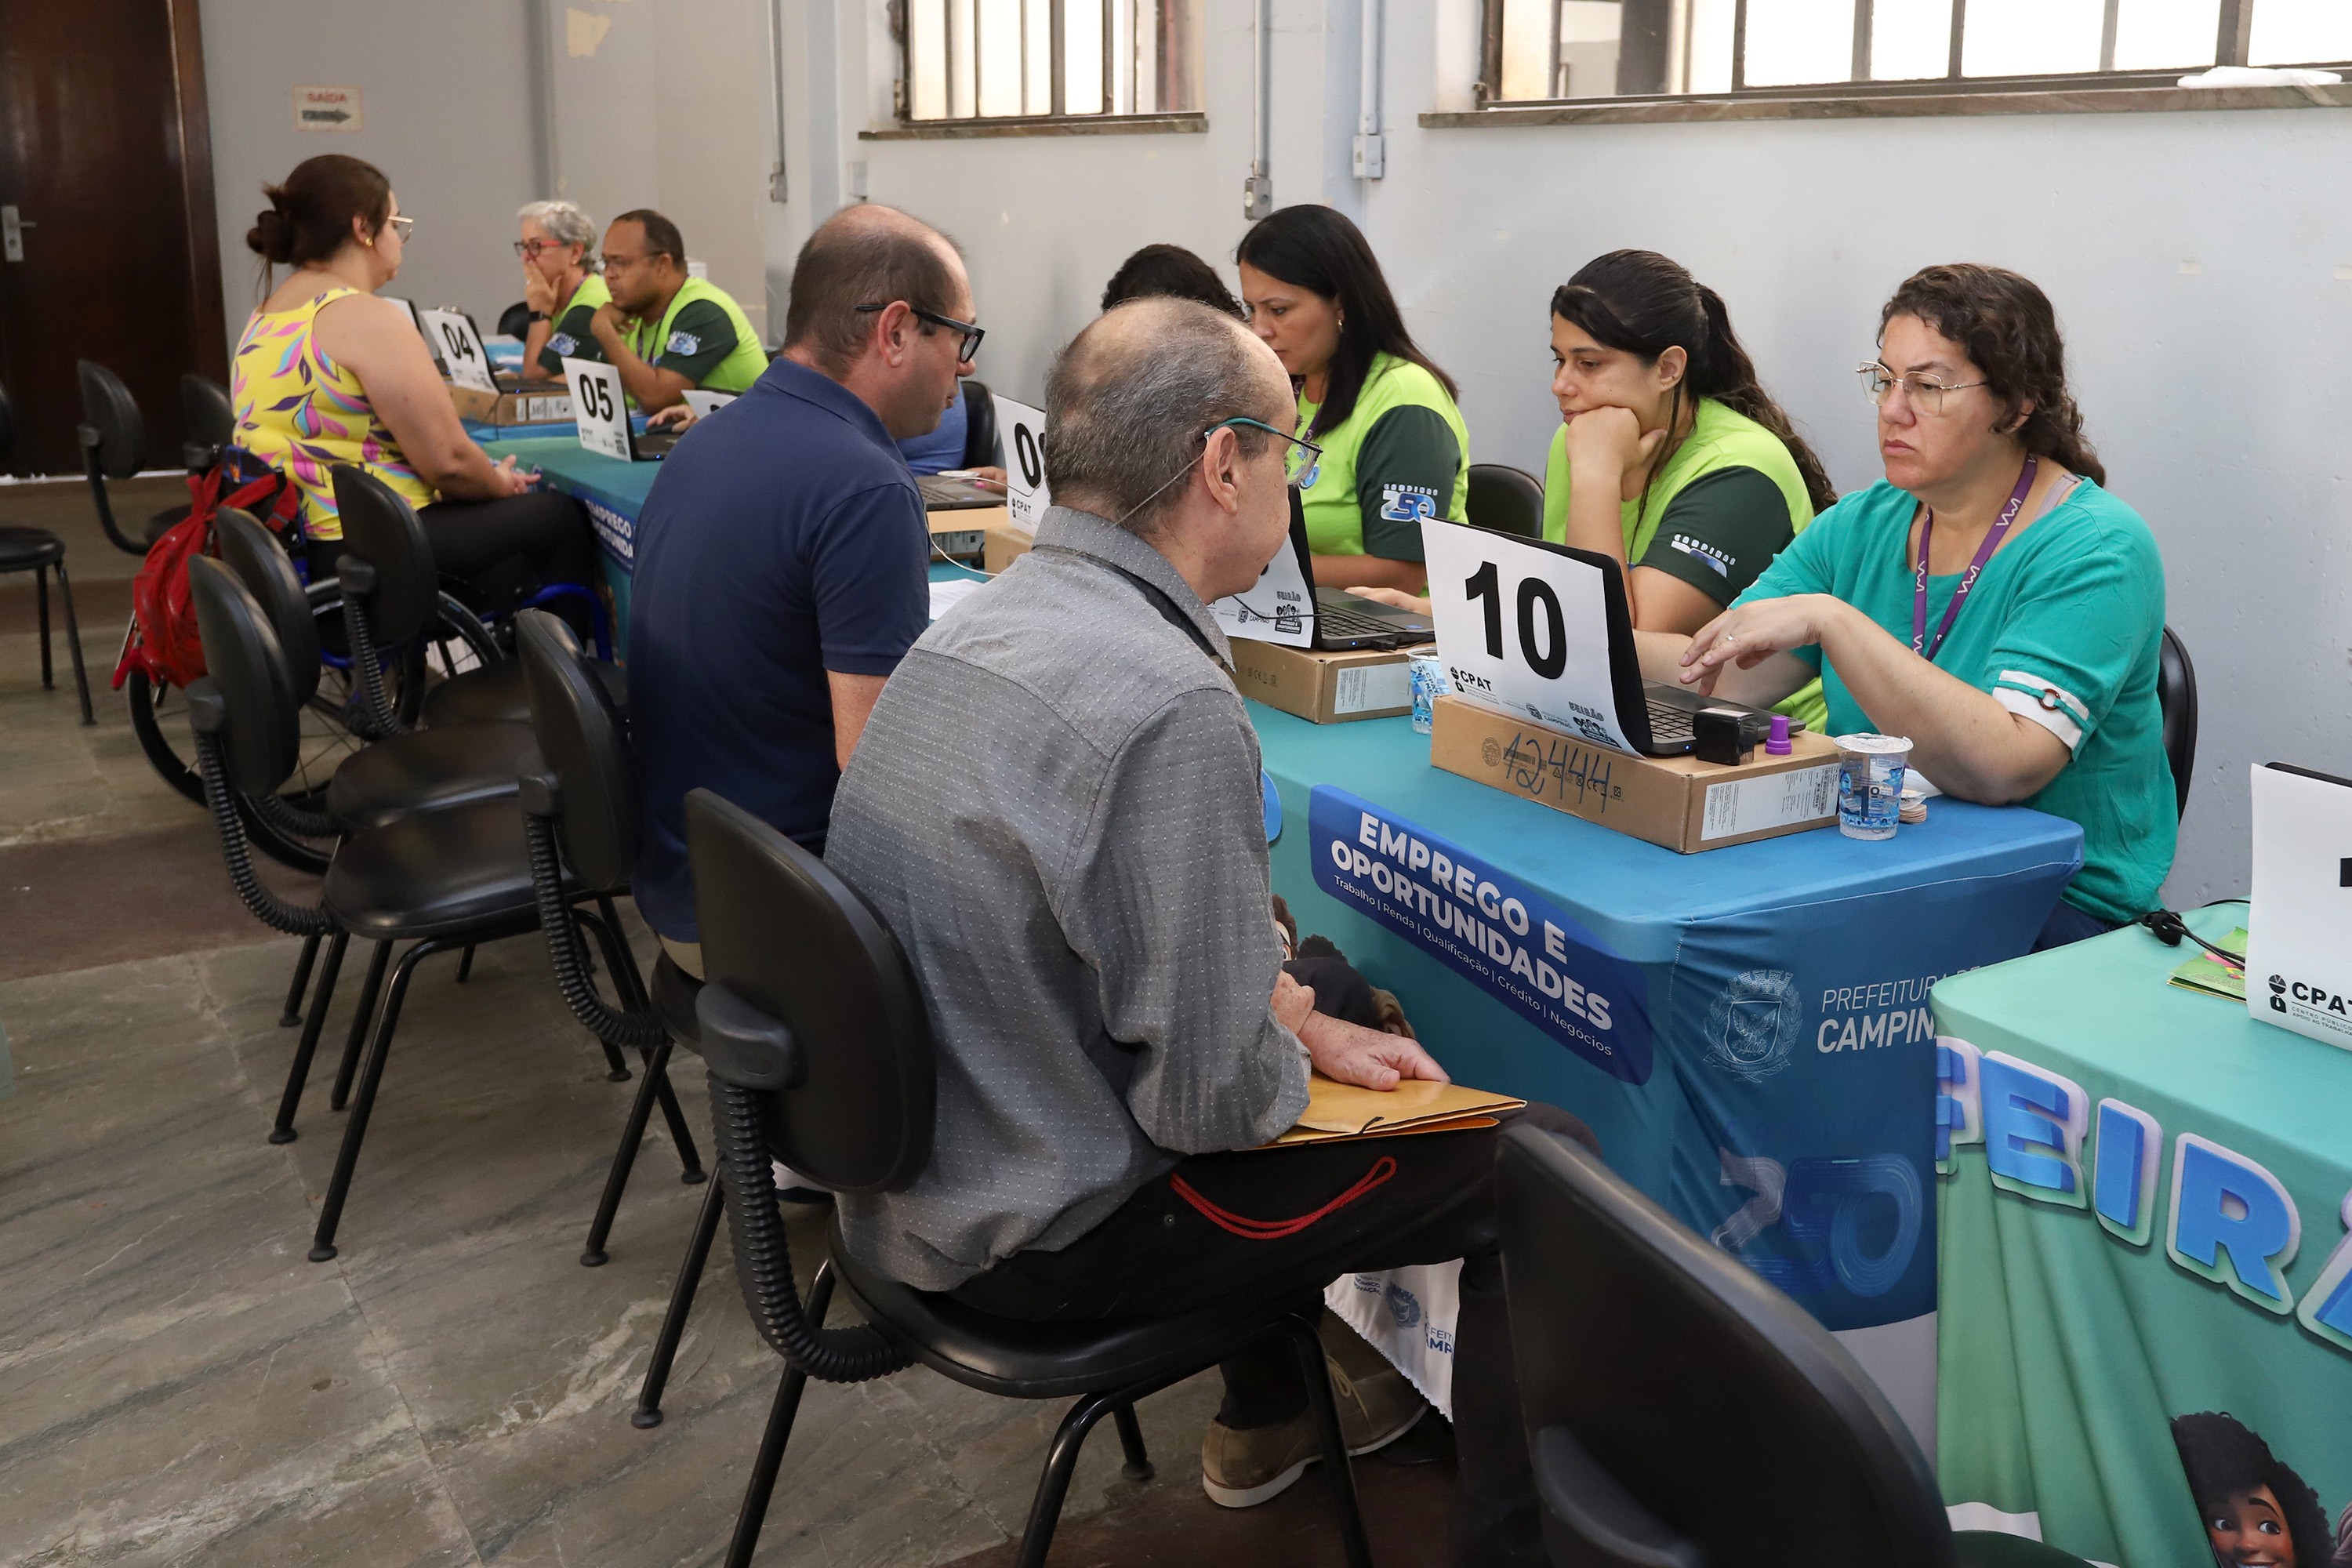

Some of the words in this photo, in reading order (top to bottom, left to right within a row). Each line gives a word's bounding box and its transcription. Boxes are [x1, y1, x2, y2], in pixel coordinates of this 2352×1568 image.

[307, 91, 347, 103] SAÍDA
[442, 322, 475, 363] 04
[579, 373, 614, 423] 05
[1014, 422, 1047, 489] 0
[1016, 499, 1032, 515] CPAT
[1380, 489, 1436, 523] 250
[1383, 483, 1439, 496] CAMPINAS
[1674, 533, 1737, 565] CAMPINAS
[1465, 561, 1567, 680] 10
[1460, 670, 1492, 691] CPAT
[1359, 811, 1530, 936] EMPREGO
[1544, 919, 1568, 964] E
[1330, 839, 1613, 1031] OPORTUNIDADES
[1334, 874, 1376, 906] Trabalho
[1383, 902, 1415, 929] Renda
[1423, 927, 1490, 977] Qualificação
[1497, 975, 1541, 1011] Crédito
[1550, 1009, 1613, 1056] Negócios
[1821, 973, 1947, 1014] PREFEITUR
[2292, 1006, 2318, 1019] CENTRO
[1817, 1007, 1937, 1054] CAMPIN
[2292, 1012, 2310, 1022] APOIO
